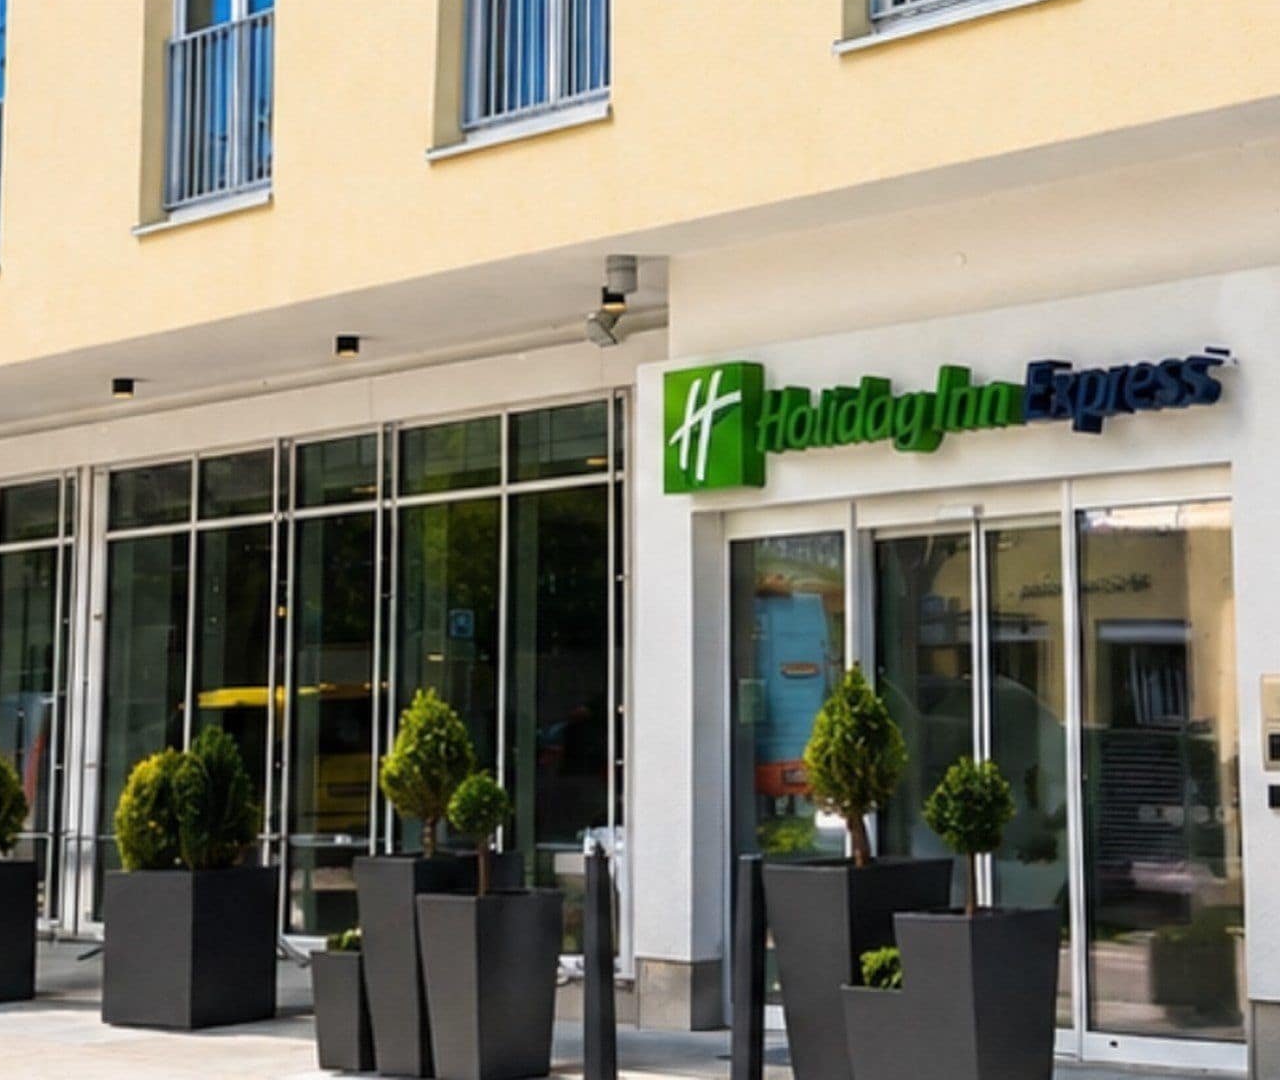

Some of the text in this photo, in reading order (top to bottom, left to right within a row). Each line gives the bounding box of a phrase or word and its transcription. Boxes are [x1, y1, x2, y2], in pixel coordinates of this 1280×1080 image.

[756, 359, 1222, 453] Holiday Inn Express
